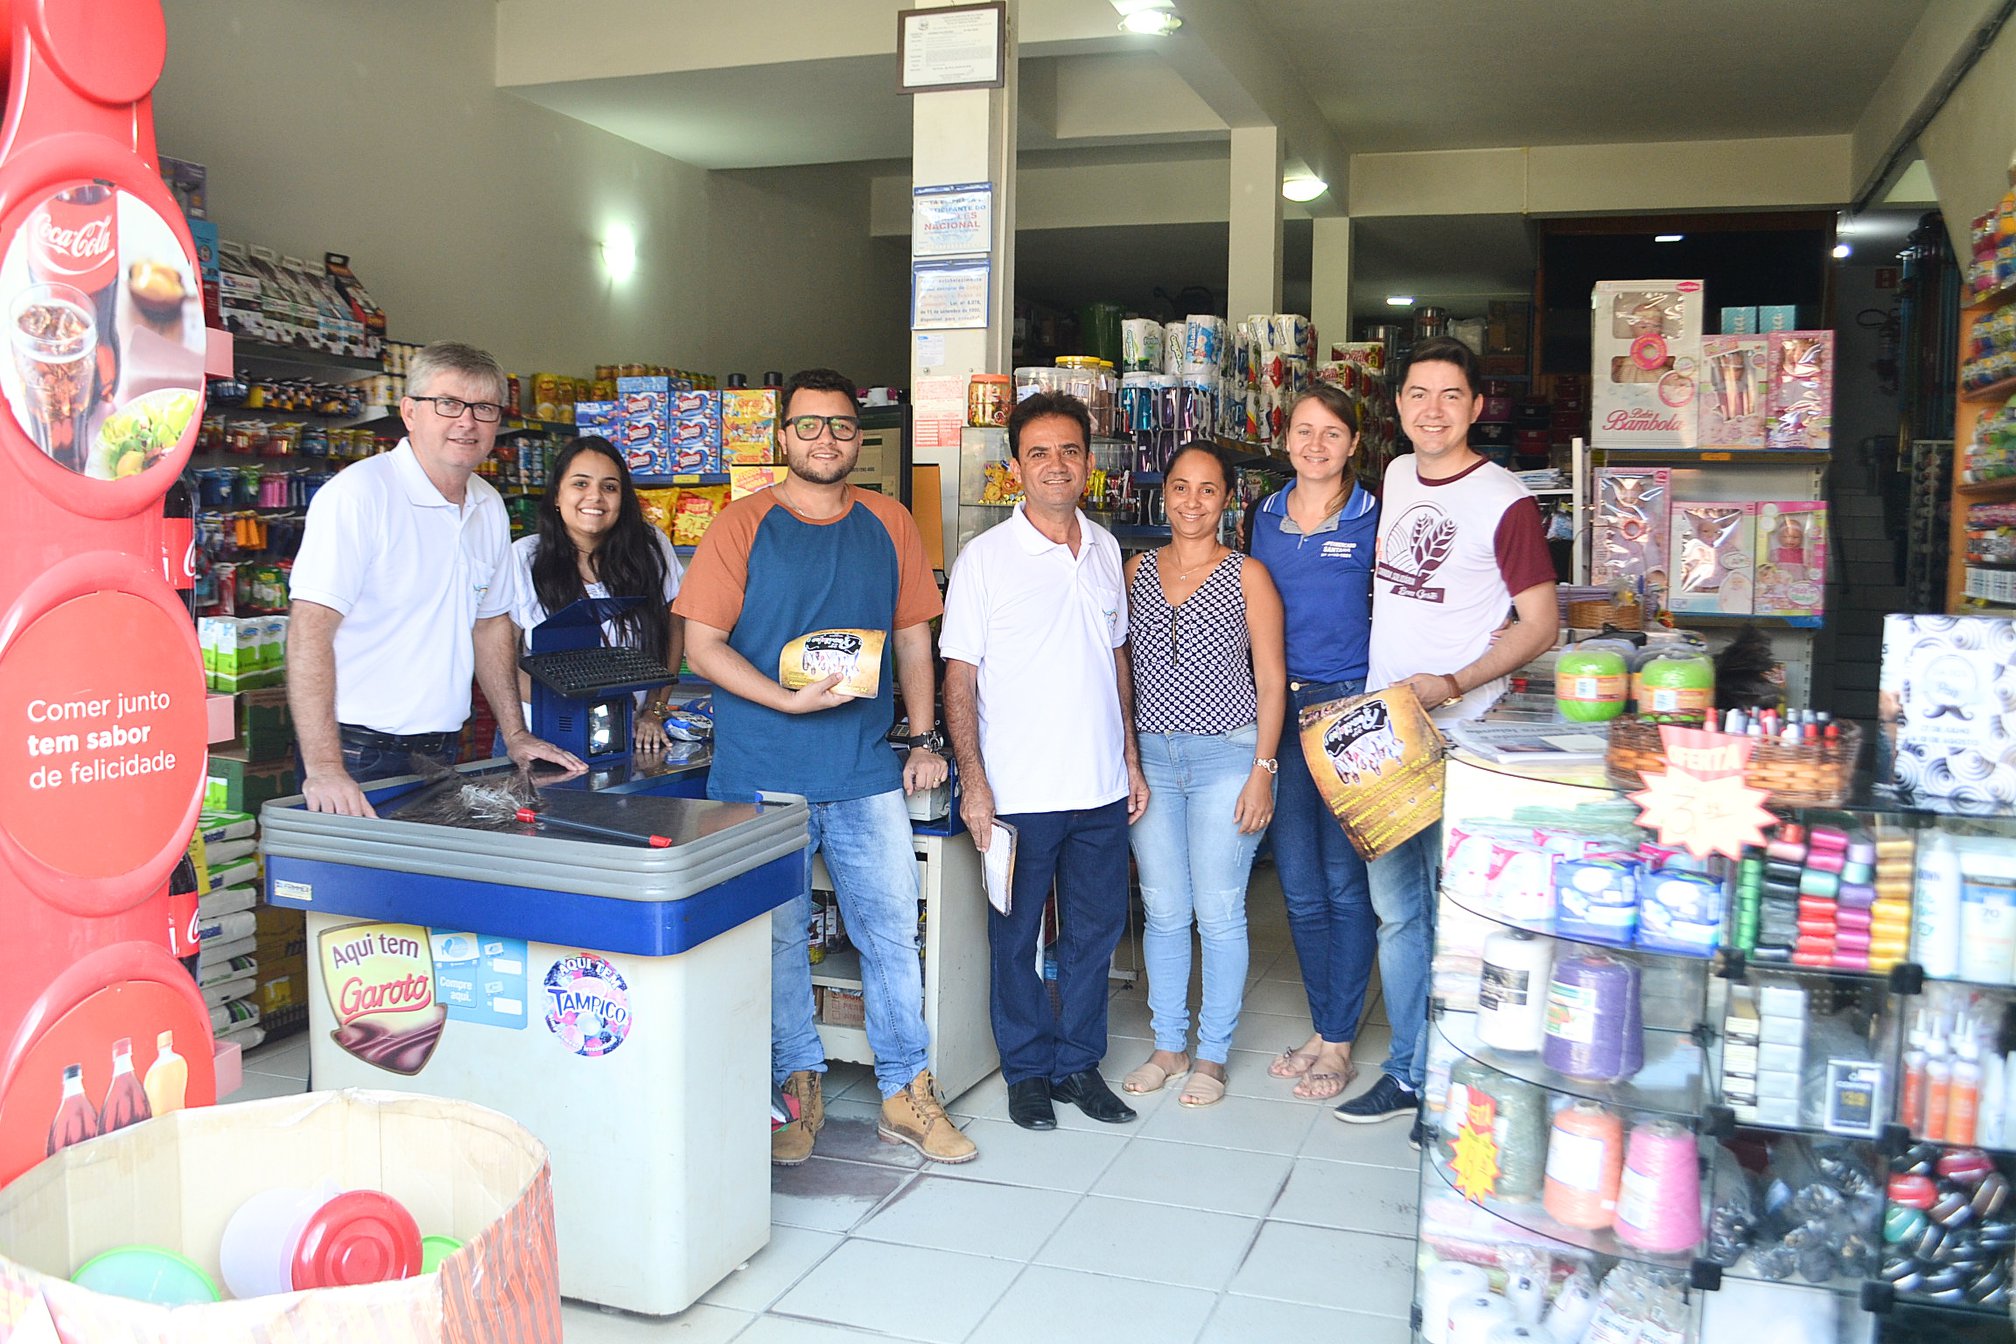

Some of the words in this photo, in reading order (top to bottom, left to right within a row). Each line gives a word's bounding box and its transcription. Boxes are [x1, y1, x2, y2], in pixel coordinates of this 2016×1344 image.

[924, 221, 980, 231] NACIONAL
[1602, 410, 1684, 431] Bambola
[27, 699, 112, 723] Comer
[116, 690, 171, 719] junto
[27, 734, 79, 757] tem
[86, 724, 151, 750] sabor
[29, 766, 63, 789] de
[70, 750, 176, 785] felicidade
[1667, 744, 1742, 772] OFERTA
[332, 932, 375, 969] Aqui
[378, 932, 419, 959] tem
[440, 976, 473, 991] Compre
[559, 957, 592, 977] AQUI
[595, 961, 622, 990] TEM
[340, 973, 431, 1015] Garoto
[547, 988, 627, 1023] TAMPICO
